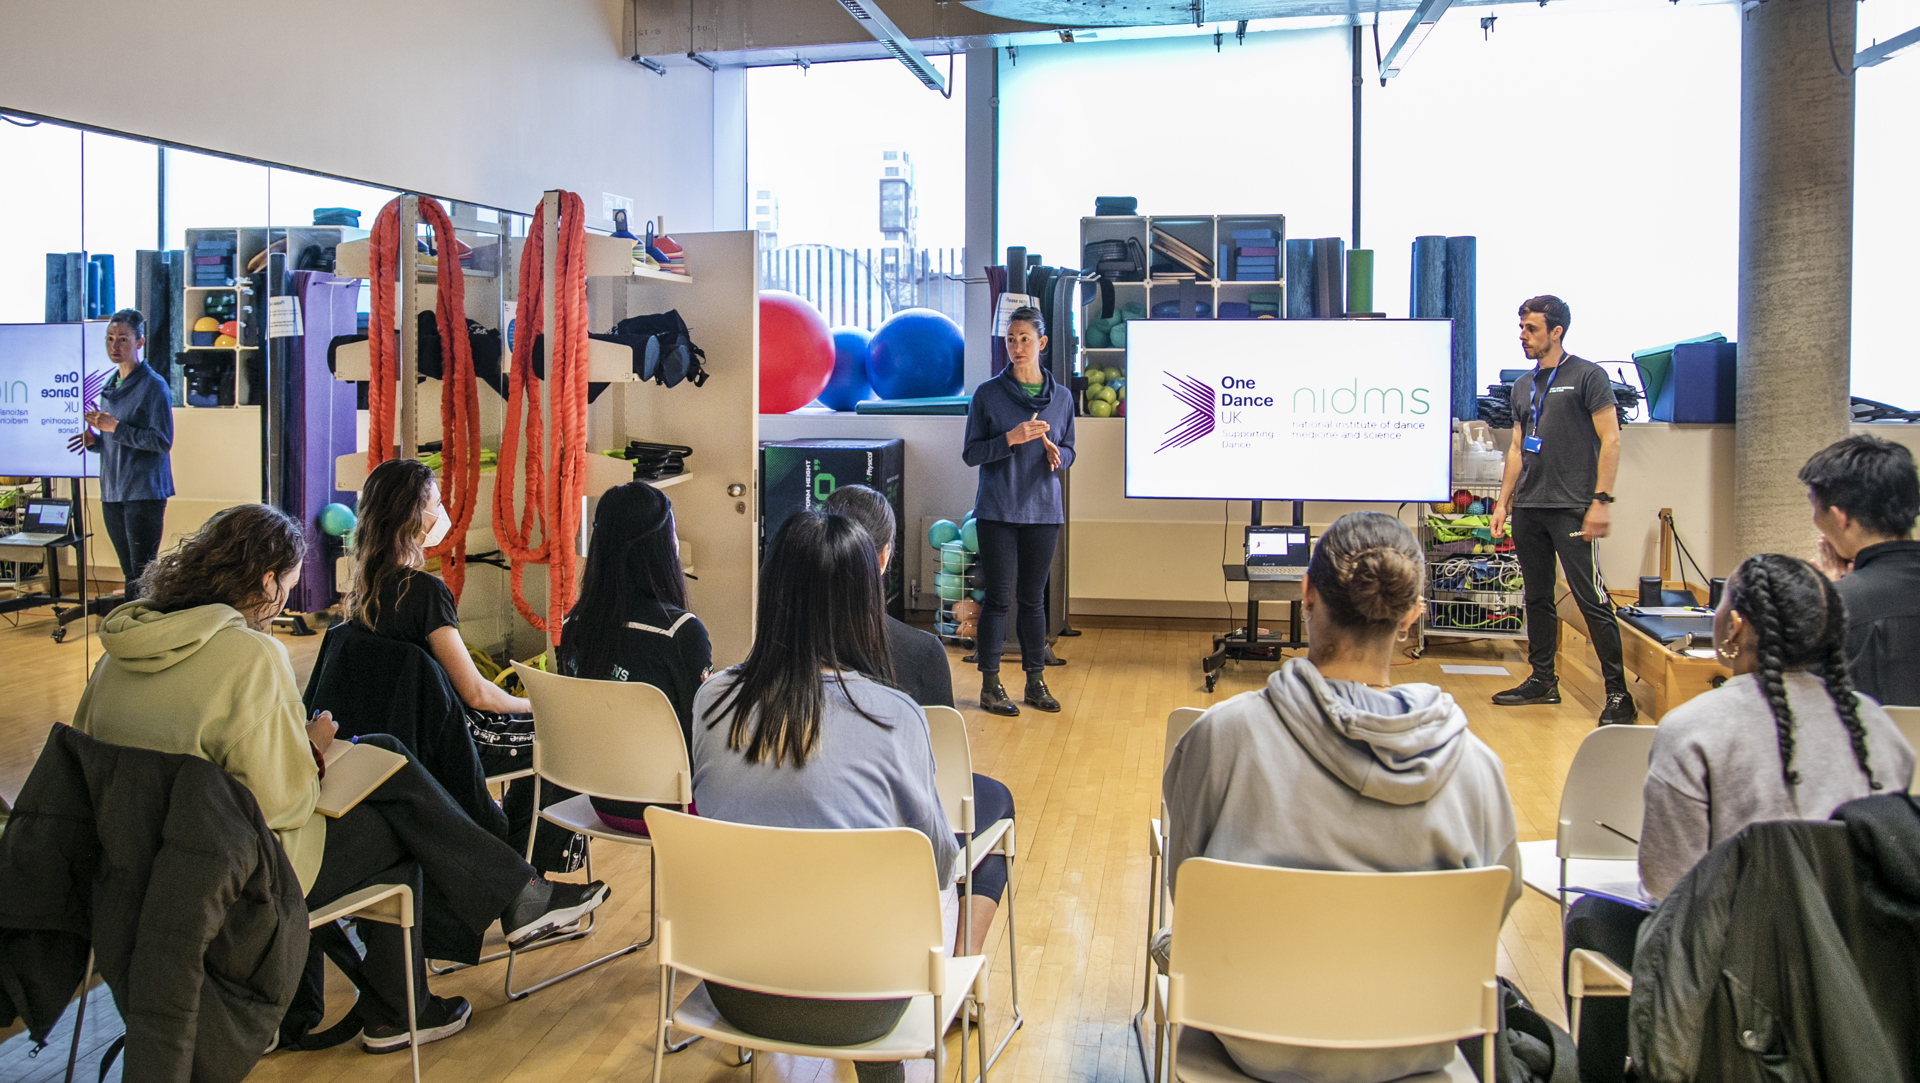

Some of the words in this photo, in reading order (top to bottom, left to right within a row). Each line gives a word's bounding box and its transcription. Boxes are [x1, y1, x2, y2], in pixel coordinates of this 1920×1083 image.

[1221, 376, 1256, 389] One
[1221, 393, 1274, 407] Dance
[1293, 377, 1430, 415] nidms
[1221, 411, 1242, 424] UK
[1292, 420, 1333, 429] national
[1335, 420, 1377, 429] institute
[1379, 420, 1391, 429] of
[1393, 420, 1425, 429] dance
[1222, 429, 1274, 439] Supporting
[1292, 430, 1339, 439] medicine
[1341, 430, 1361, 439] and
[1363, 430, 1402, 439] science
[1222, 440, 1252, 449] Dance
